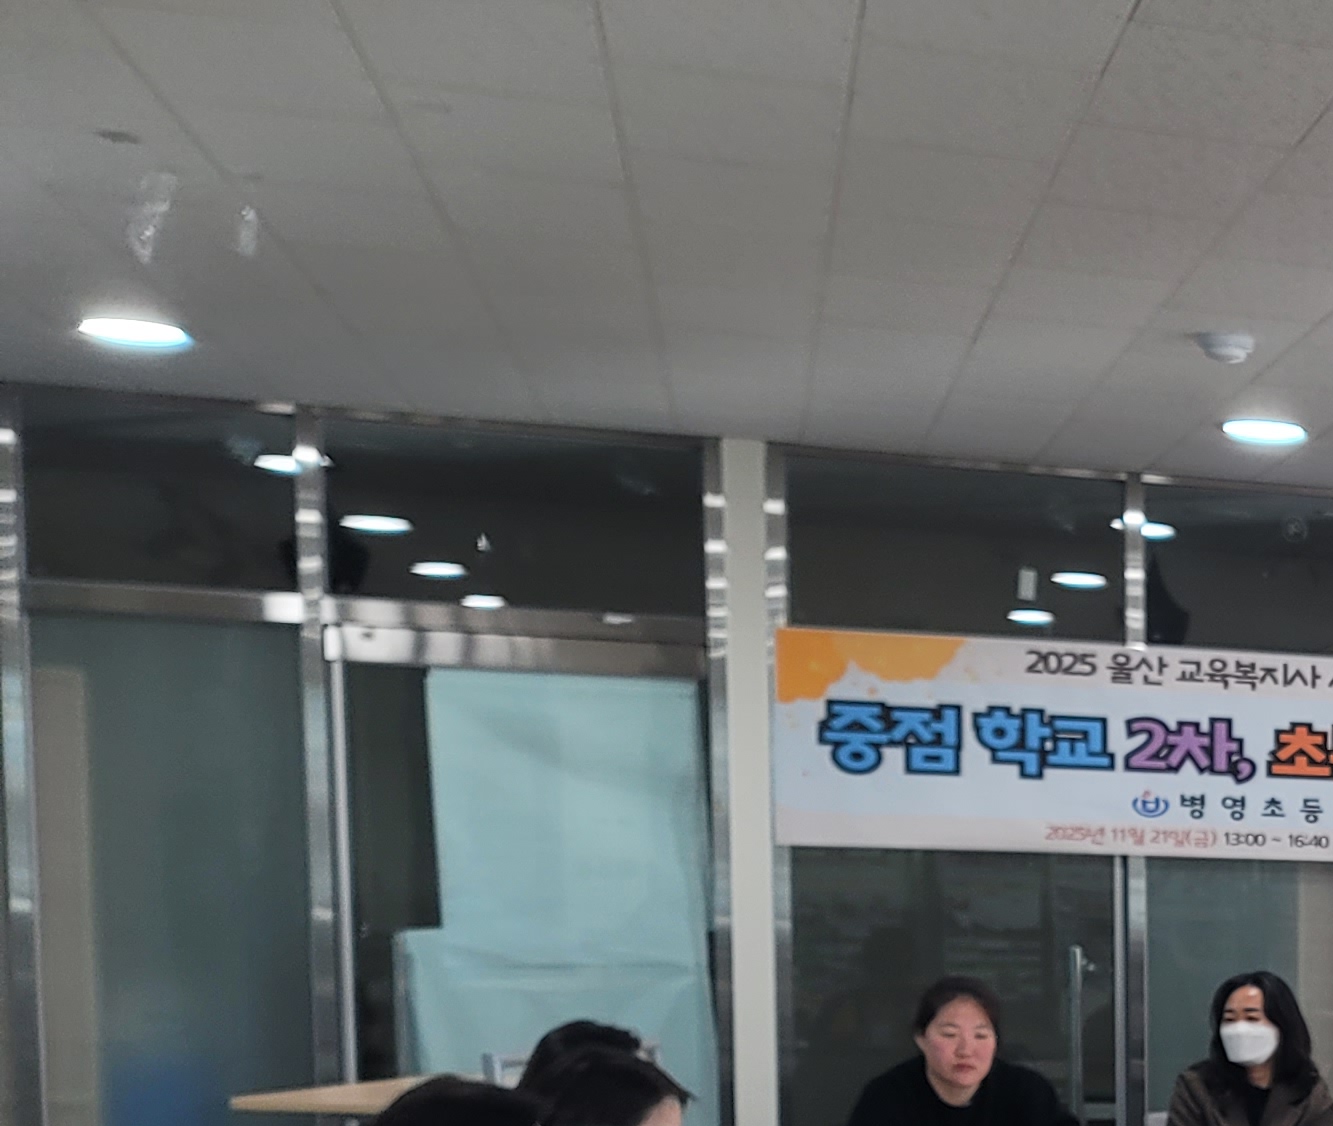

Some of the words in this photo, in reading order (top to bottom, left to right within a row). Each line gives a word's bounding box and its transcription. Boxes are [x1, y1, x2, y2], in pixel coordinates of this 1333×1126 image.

[1024, 650, 1097, 676] 2025
[1106, 653, 1168, 686] 울산
[1176, 660, 1320, 691] 교육복지사
[818, 699, 963, 775] 중점
[972, 705, 1115, 779] 학교
[1124, 716, 1256, 784] 2차,
[1045, 826, 1106, 845] 2025년
[1112, 828, 1145, 845] 11월
[1223, 831, 1266, 847] 13:00
[1288, 834, 1330, 849] 16:40
